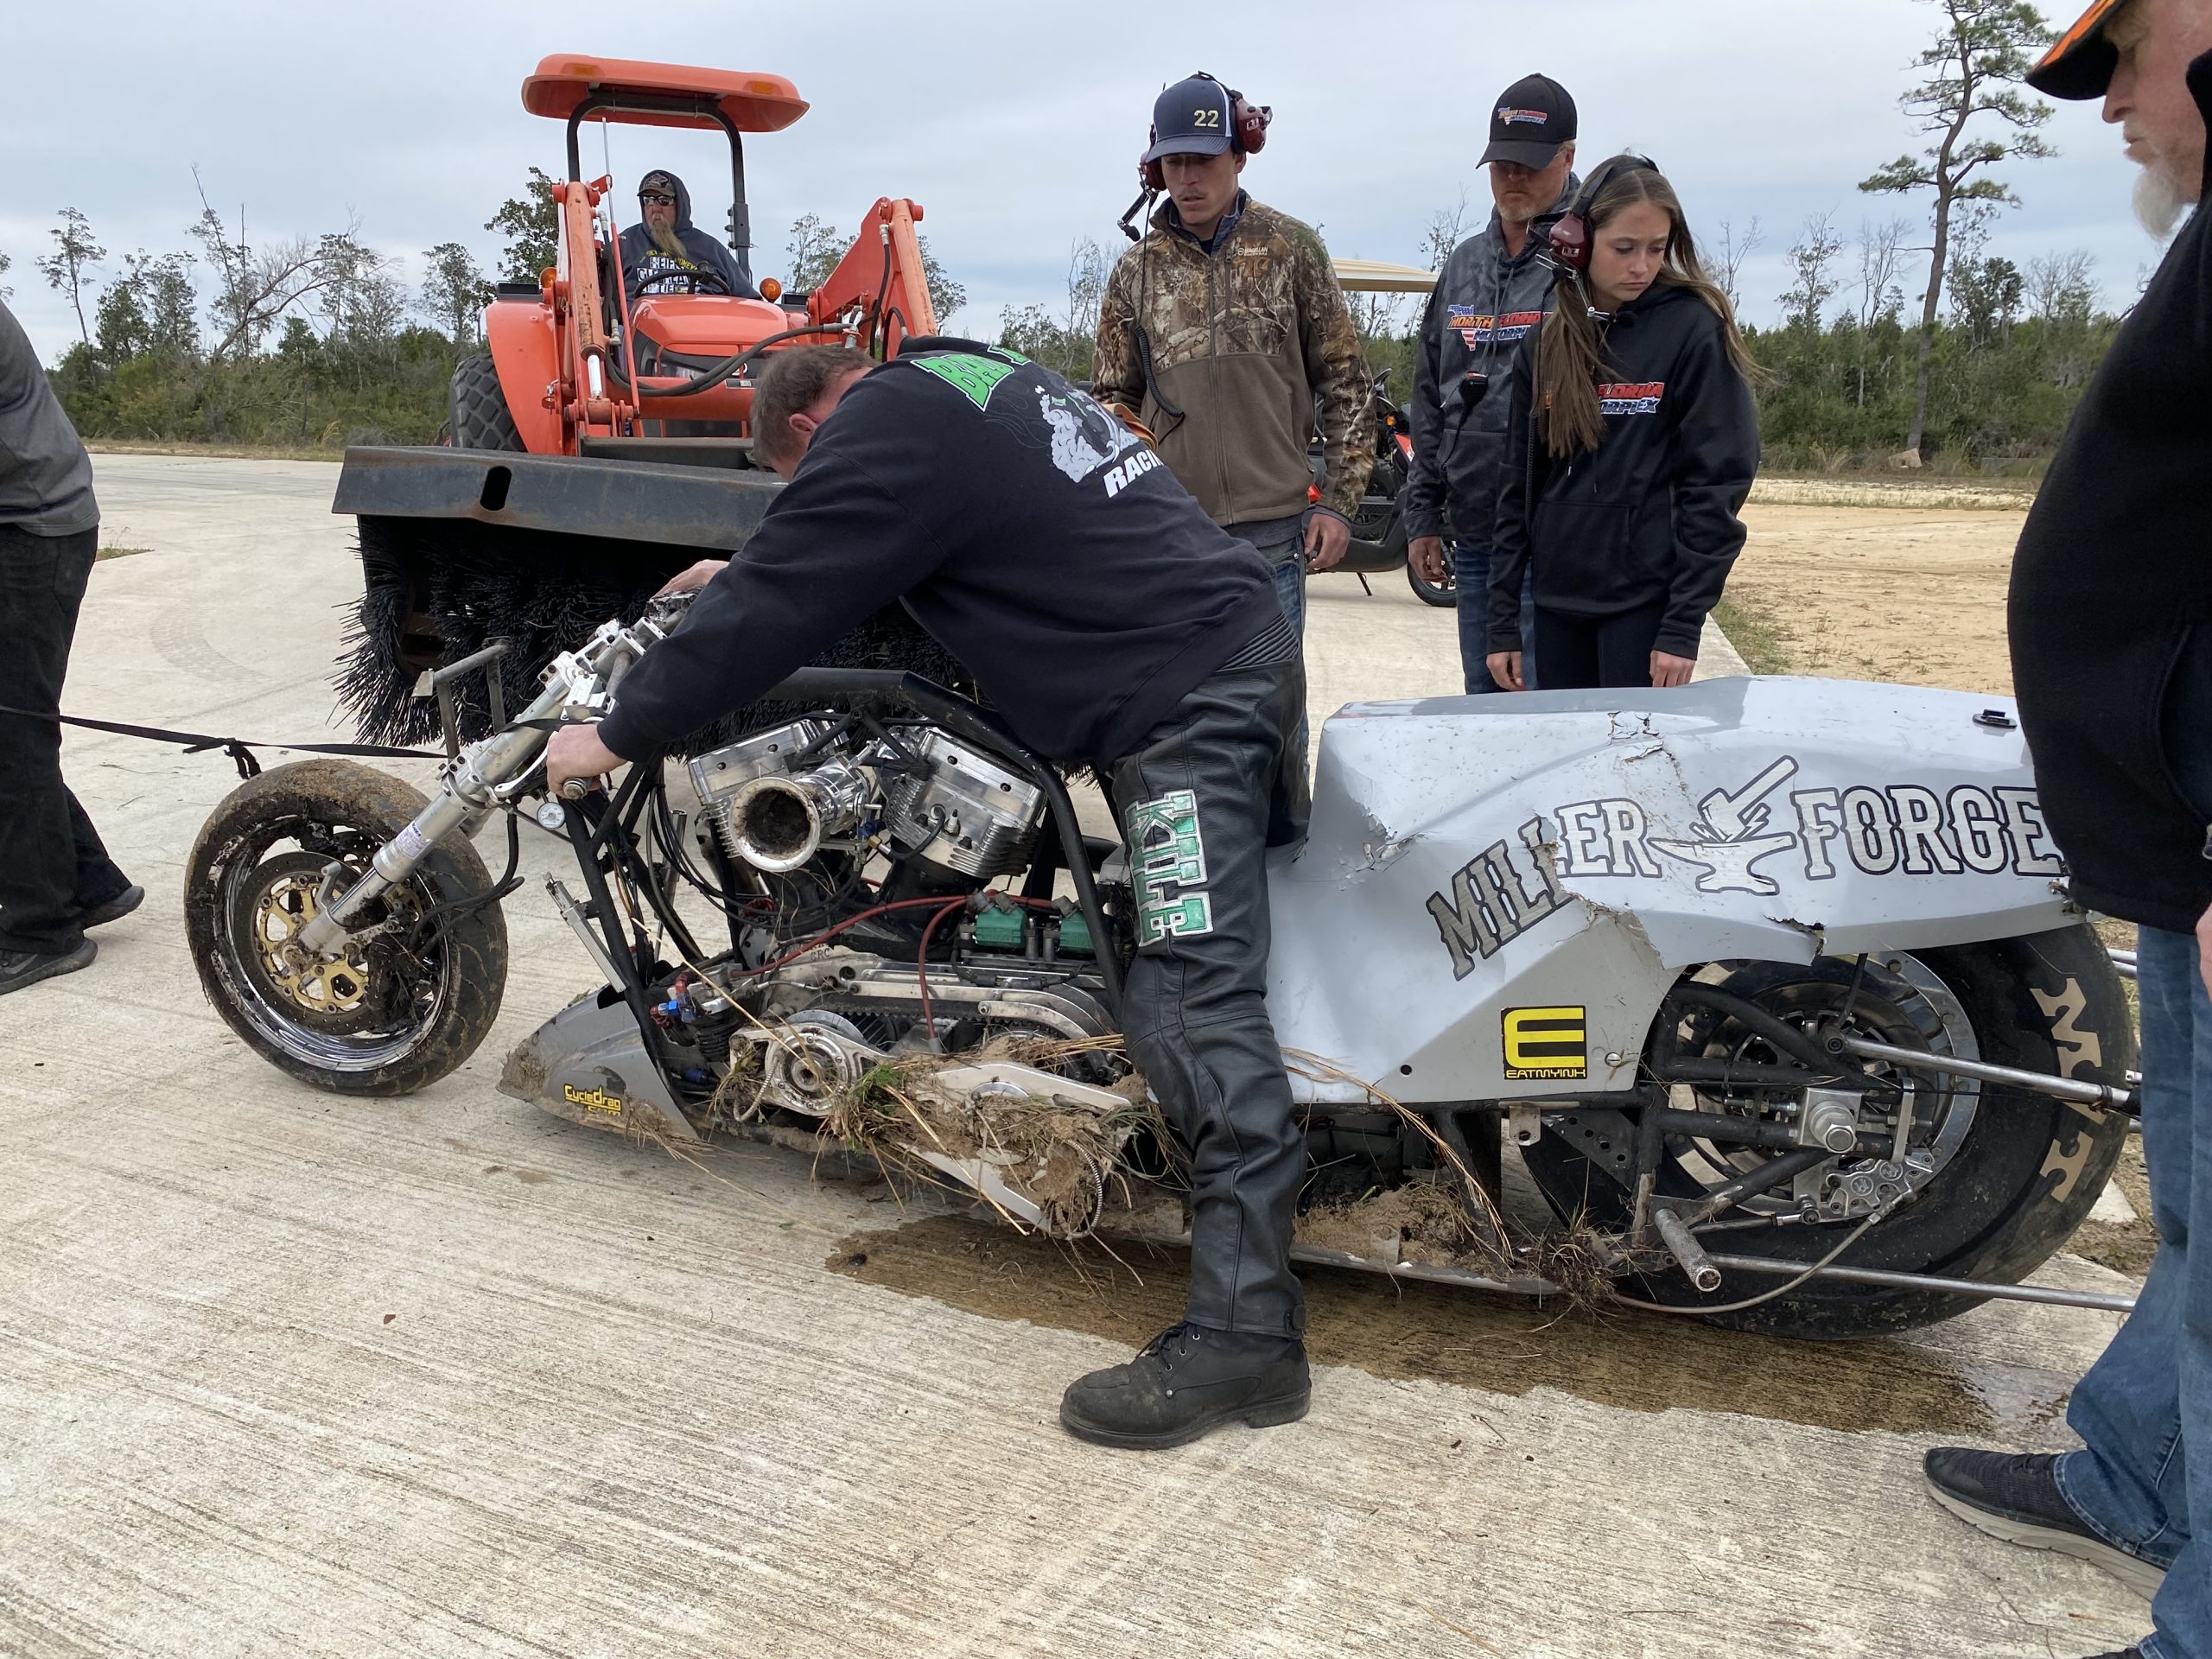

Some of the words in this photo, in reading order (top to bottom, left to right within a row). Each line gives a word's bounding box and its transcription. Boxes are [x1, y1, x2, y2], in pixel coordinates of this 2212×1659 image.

[1193, 109, 1219, 128] 22
[1447, 315, 1495, 330] NORTH
[1426, 798, 1662, 982] MILLER
[1789, 784, 2069, 881] FORGE
[810, 948, 830, 963] SRC
